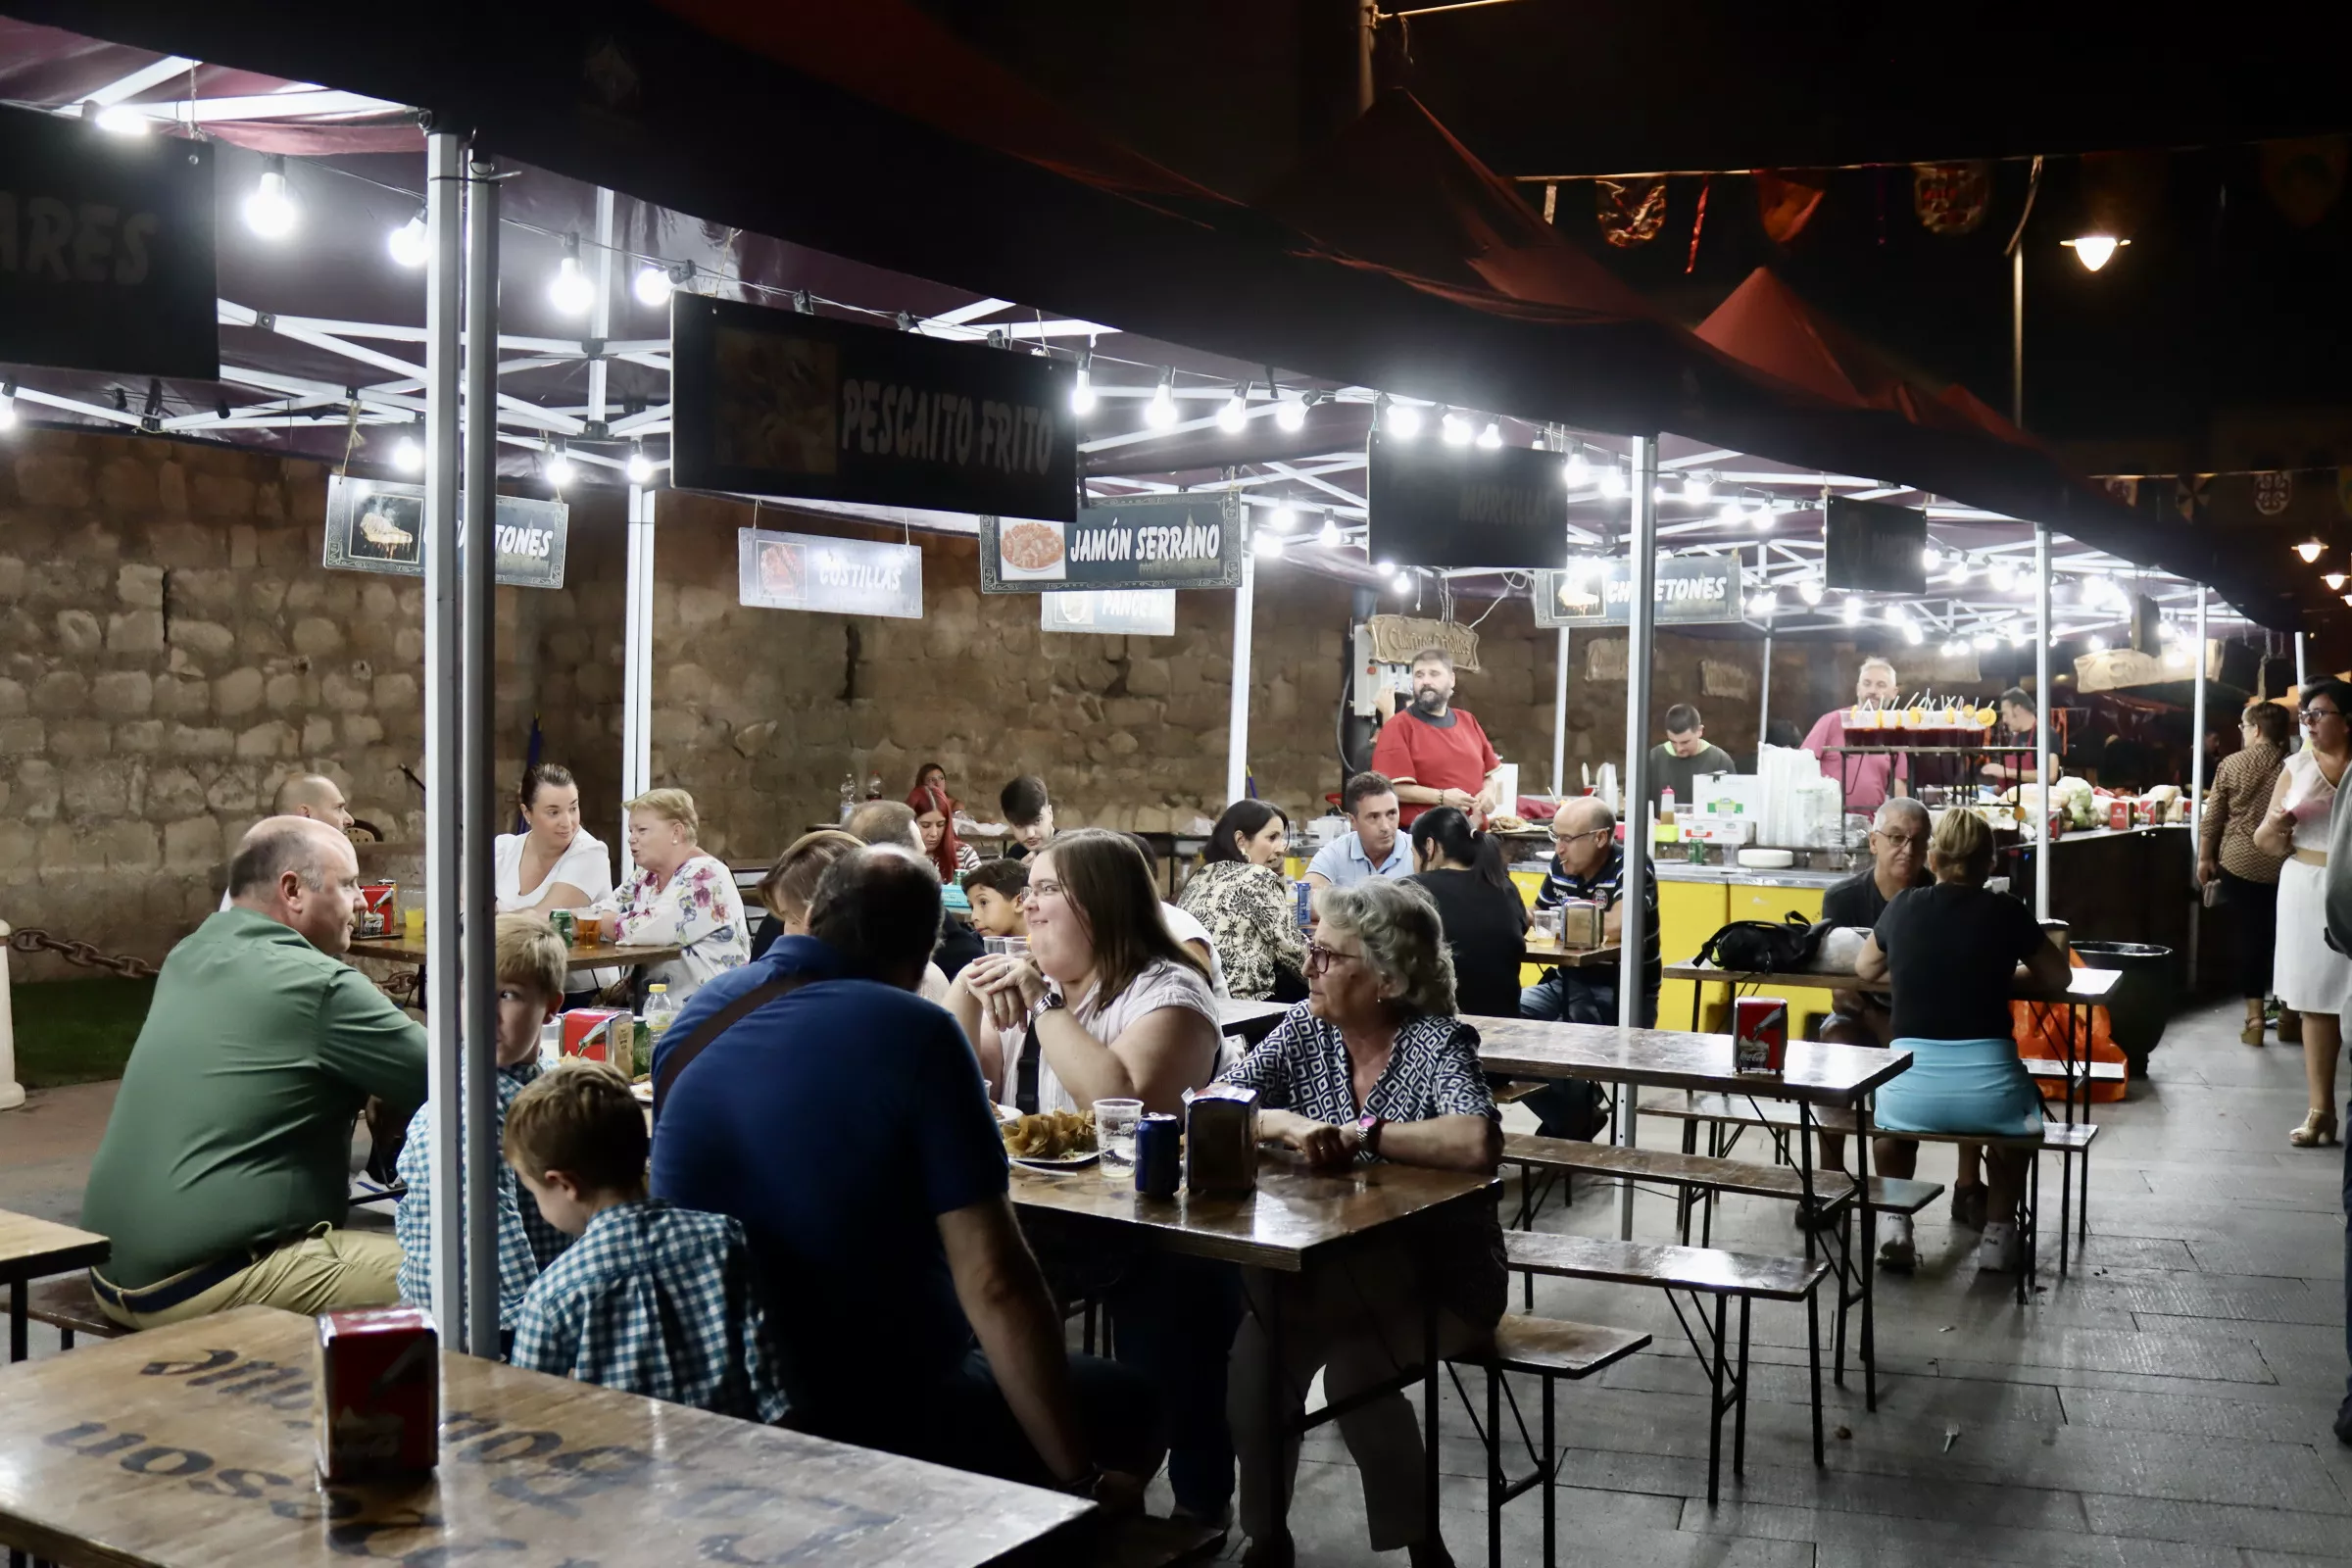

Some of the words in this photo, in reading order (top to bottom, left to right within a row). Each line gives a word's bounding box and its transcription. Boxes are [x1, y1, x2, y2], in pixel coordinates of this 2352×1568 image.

[843, 378, 973, 466] PESCAITO
[981, 399, 1054, 475] FRITO
[1070, 517, 1133, 563] JAMÓN
[1135, 523, 1220, 562] SERRANO
[819, 563, 902, 591] COSTILLAS
[1607, 576, 1728, 604] CHETONES
